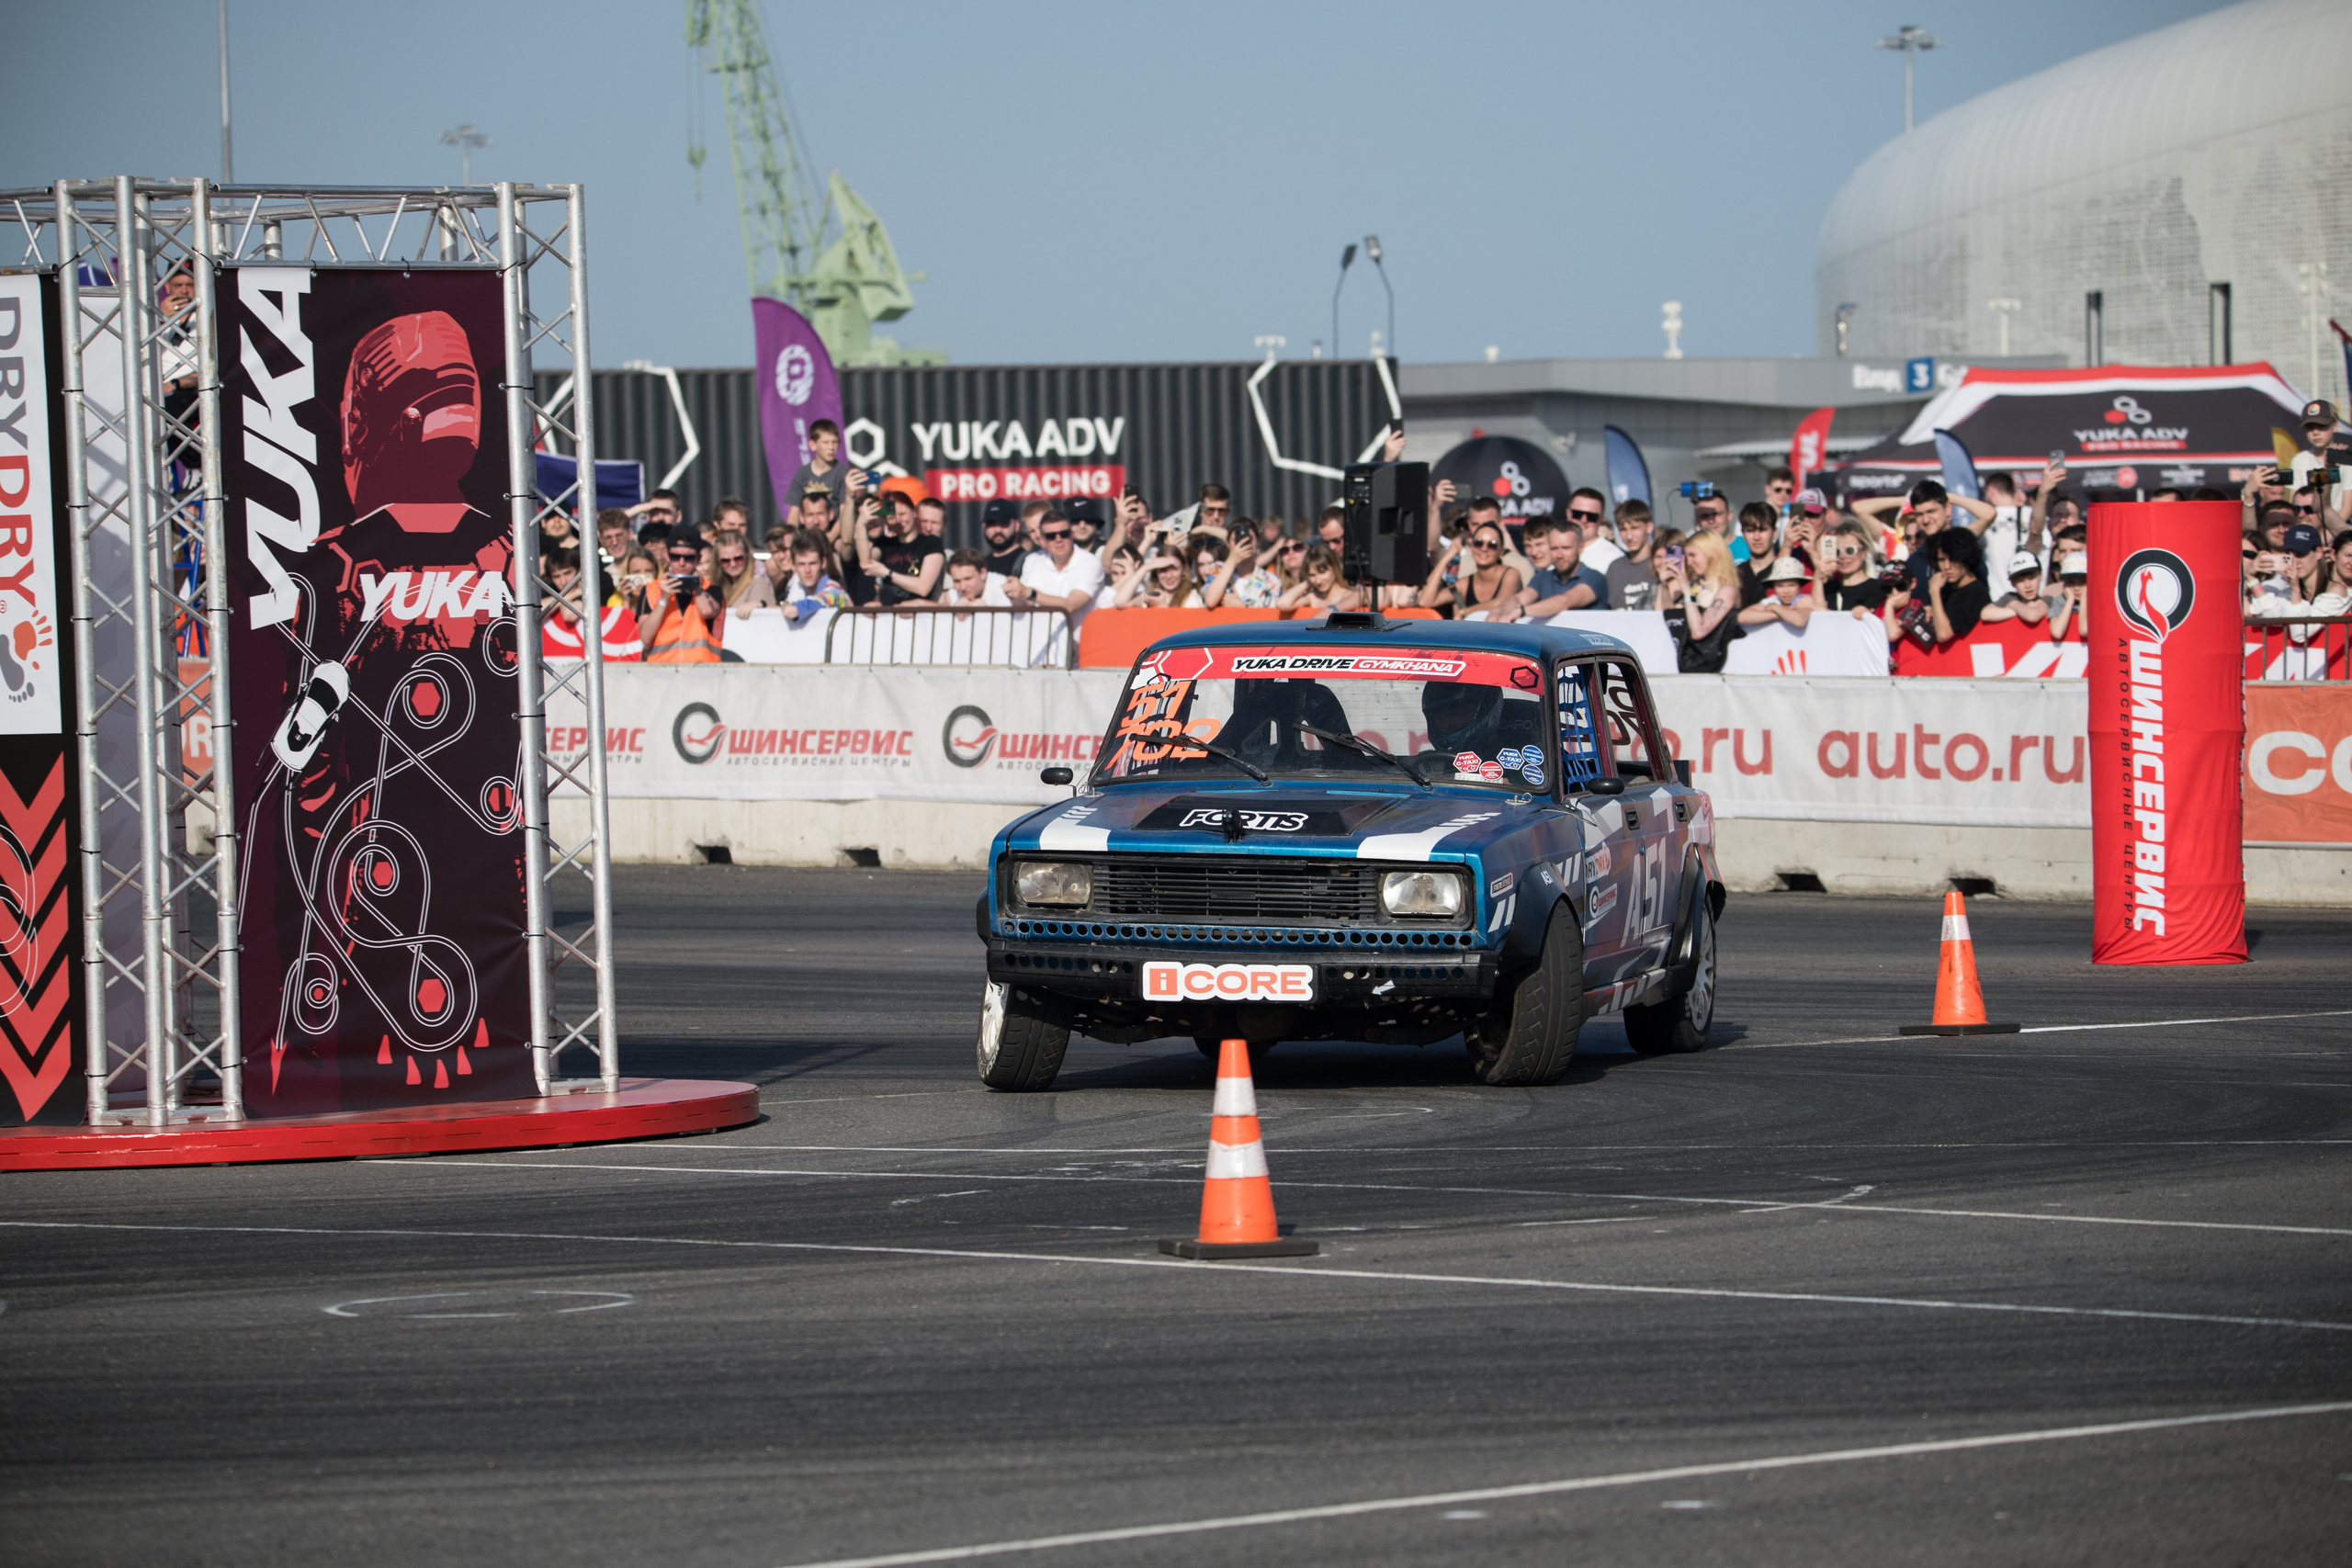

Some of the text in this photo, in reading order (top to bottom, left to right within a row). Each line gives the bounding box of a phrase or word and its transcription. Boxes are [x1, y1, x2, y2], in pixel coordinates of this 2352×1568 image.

[238, 267, 321, 630] YUKA
[910, 417, 1125, 461] YUKA ADV
[2073, 428, 2188, 442] YUKA ADV
[941, 469, 1111, 499] PRO RACING
[359, 570, 514, 622] YUKA
[1236, 659, 1453, 673] YUKA DRIVE GYMKHANA
[1121, 680, 1193, 728] 51
[727, 757, 910, 767] АВТОСЕРВИСНЫЕ ЦЕНТРЫ
[729, 729, 913, 756] ШИНСЕРВИС
[1817, 724, 2085, 784] auto.ru
[2118, 638, 2133, 931] АВТОСЕРВИСНЫЕ ЦЕНТРЫ
[2130, 638, 2165, 936] ШИНСЕРВИС
[1620, 837, 1666, 948] A51
